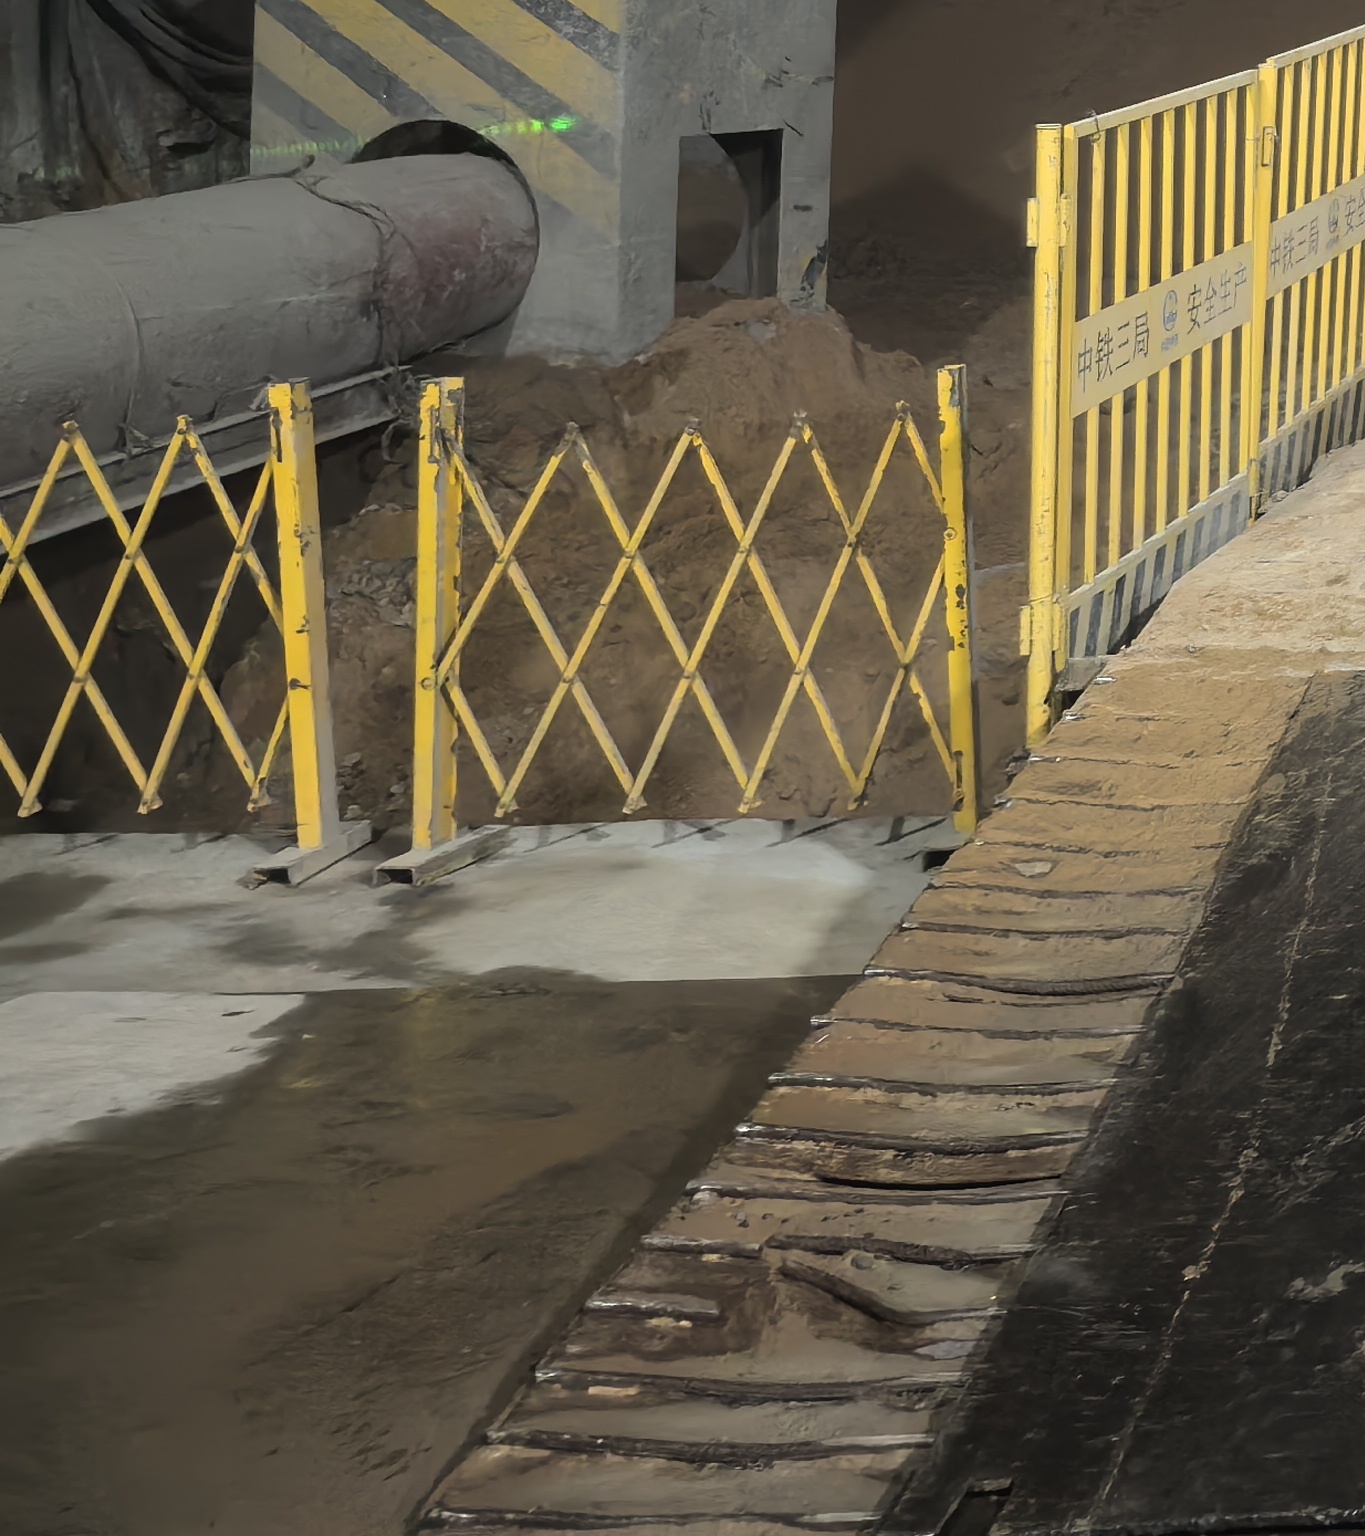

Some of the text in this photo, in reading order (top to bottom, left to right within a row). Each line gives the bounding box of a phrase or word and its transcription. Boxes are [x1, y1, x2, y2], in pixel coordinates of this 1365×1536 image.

[1269, 215, 1319, 279] 中铁三局
[1077, 262, 1247, 394] 中铁三局 安全生产
